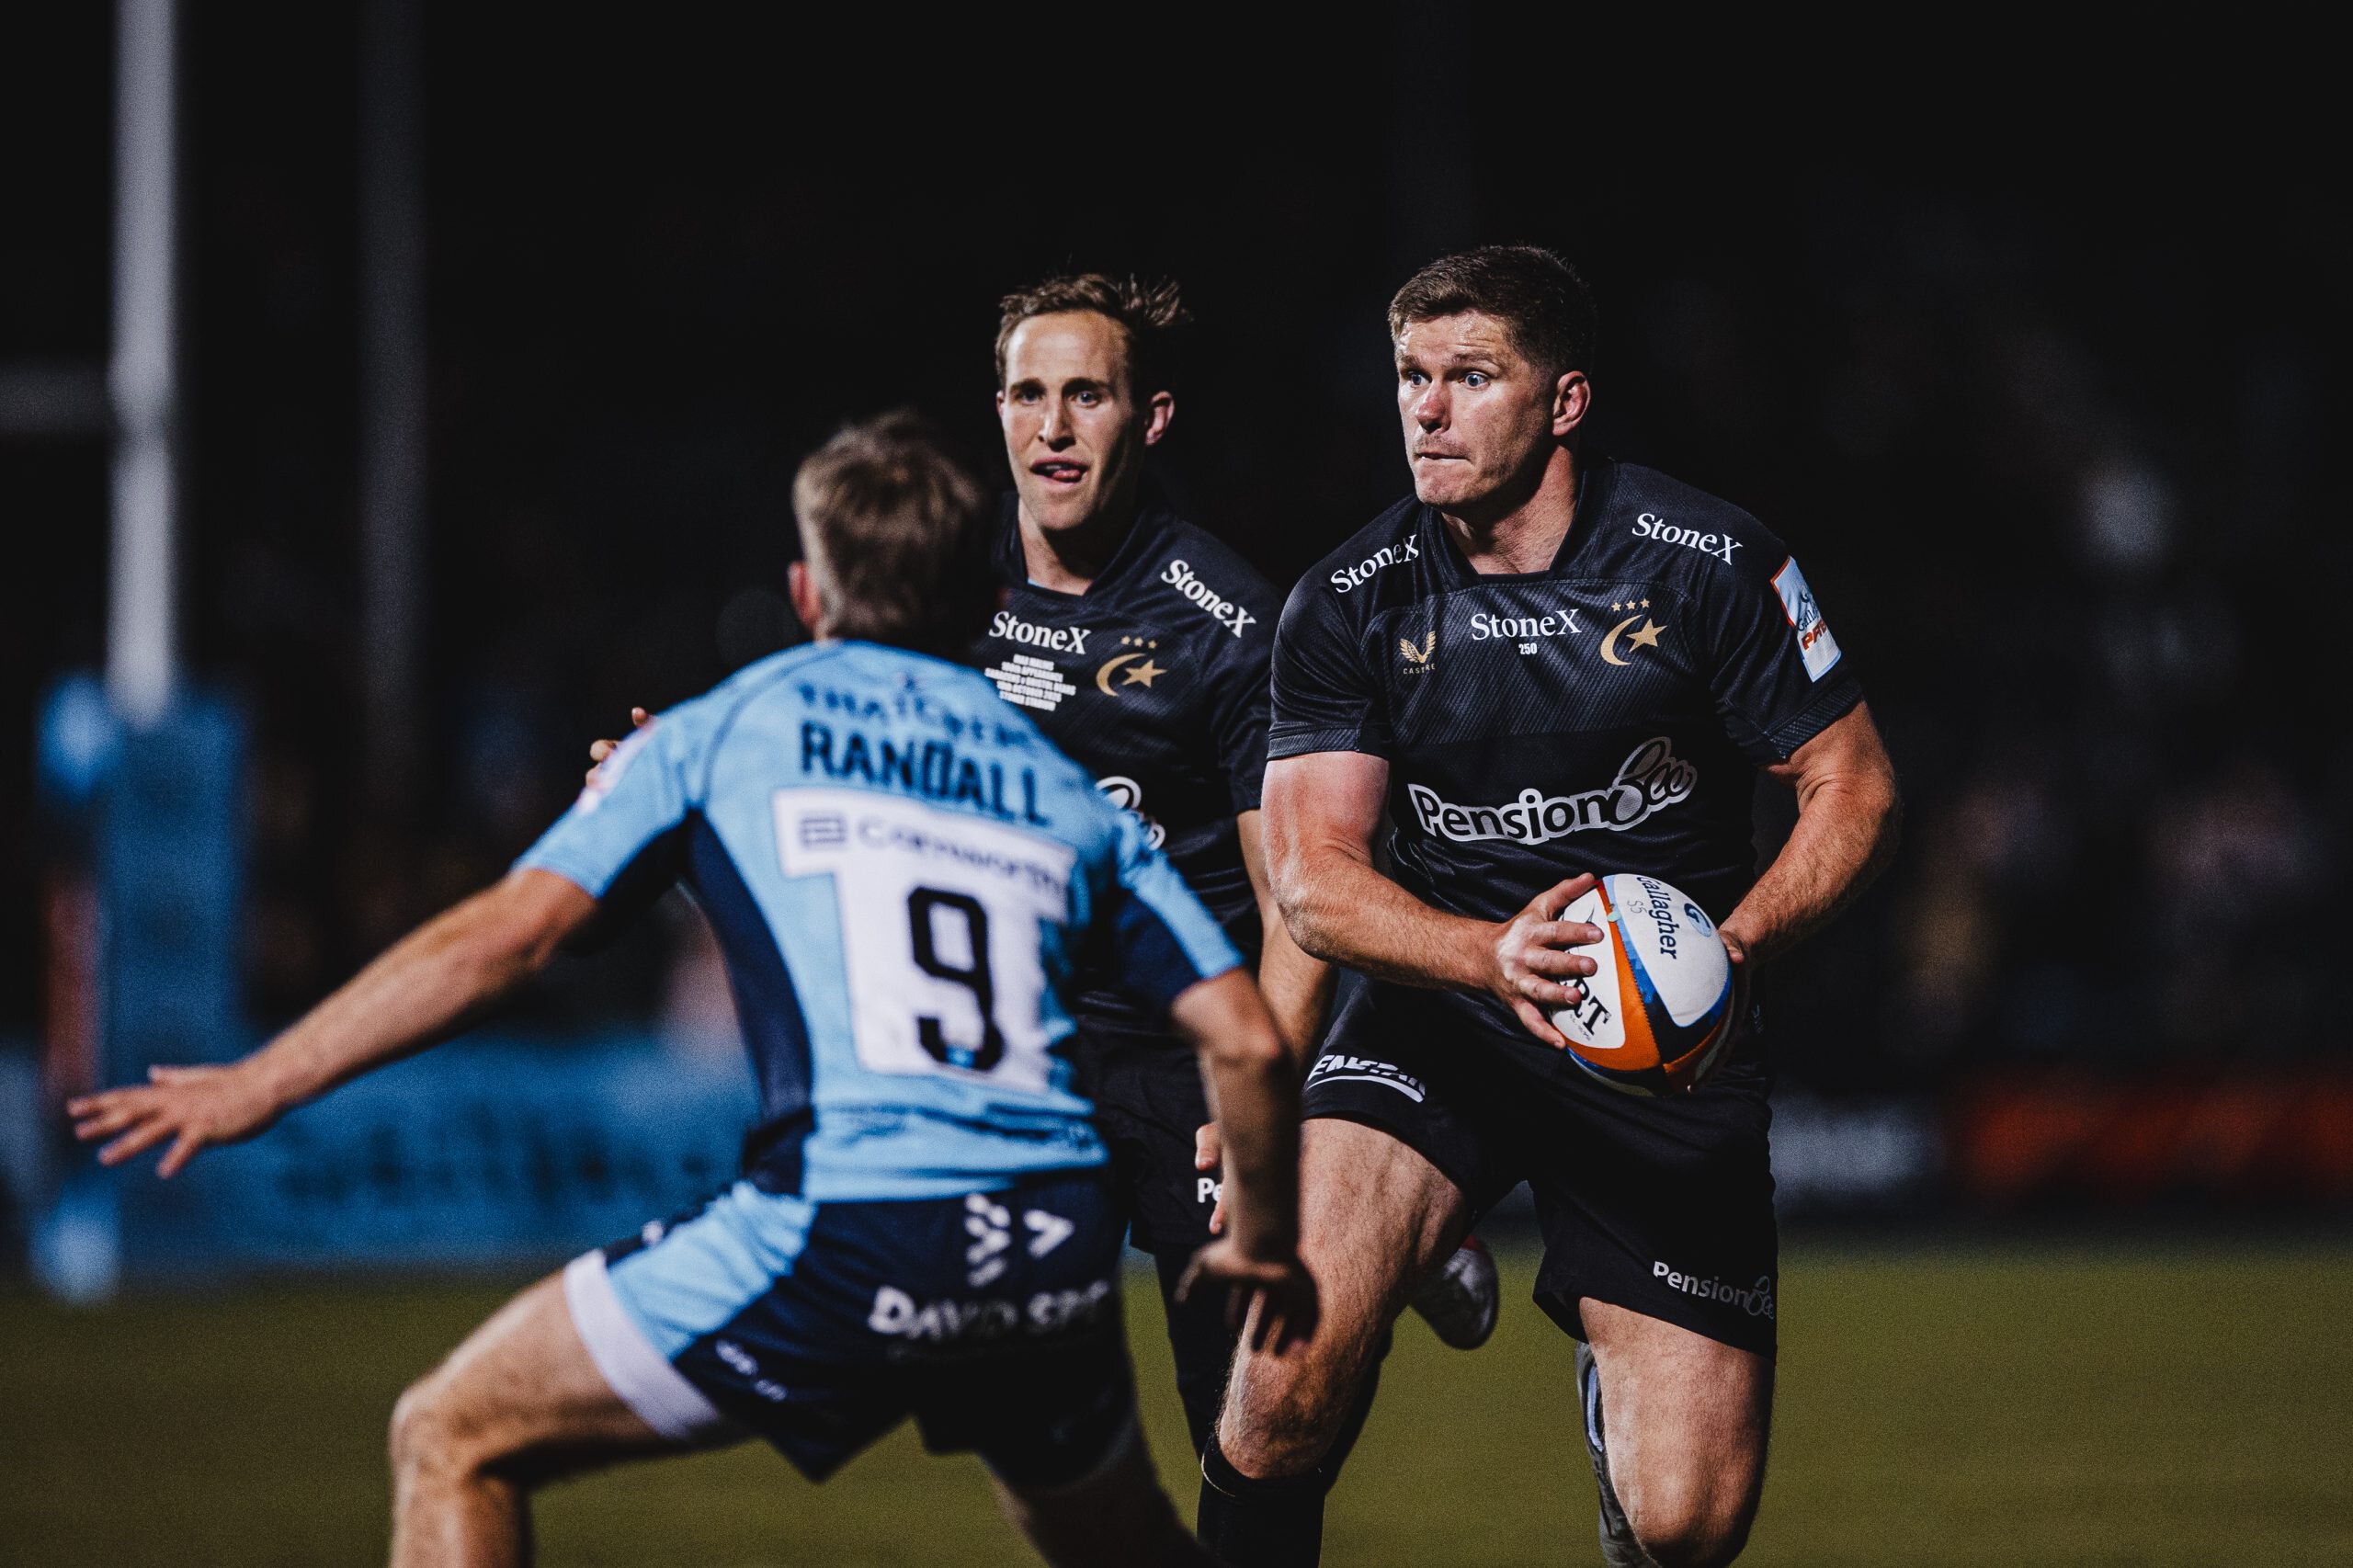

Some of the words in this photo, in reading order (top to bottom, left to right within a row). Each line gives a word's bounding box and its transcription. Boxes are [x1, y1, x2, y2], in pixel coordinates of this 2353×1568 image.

[1330, 533, 1420, 594] StoneX
[1631, 512, 1744, 565] StoneX
[1161, 559, 1256, 638] StoneX
[1471, 608, 1582, 642] StoneX
[989, 610, 1092, 655] StoneX
[1518, 642, 1538, 655] 250
[1403, 663, 1437, 676] CASTRE
[800, 719, 1053, 827] RANDALL
[1407, 734, 1699, 846] PensionBee
[1636, 875, 1681, 960] Gallagher
[907, 885, 1006, 1073] 9
